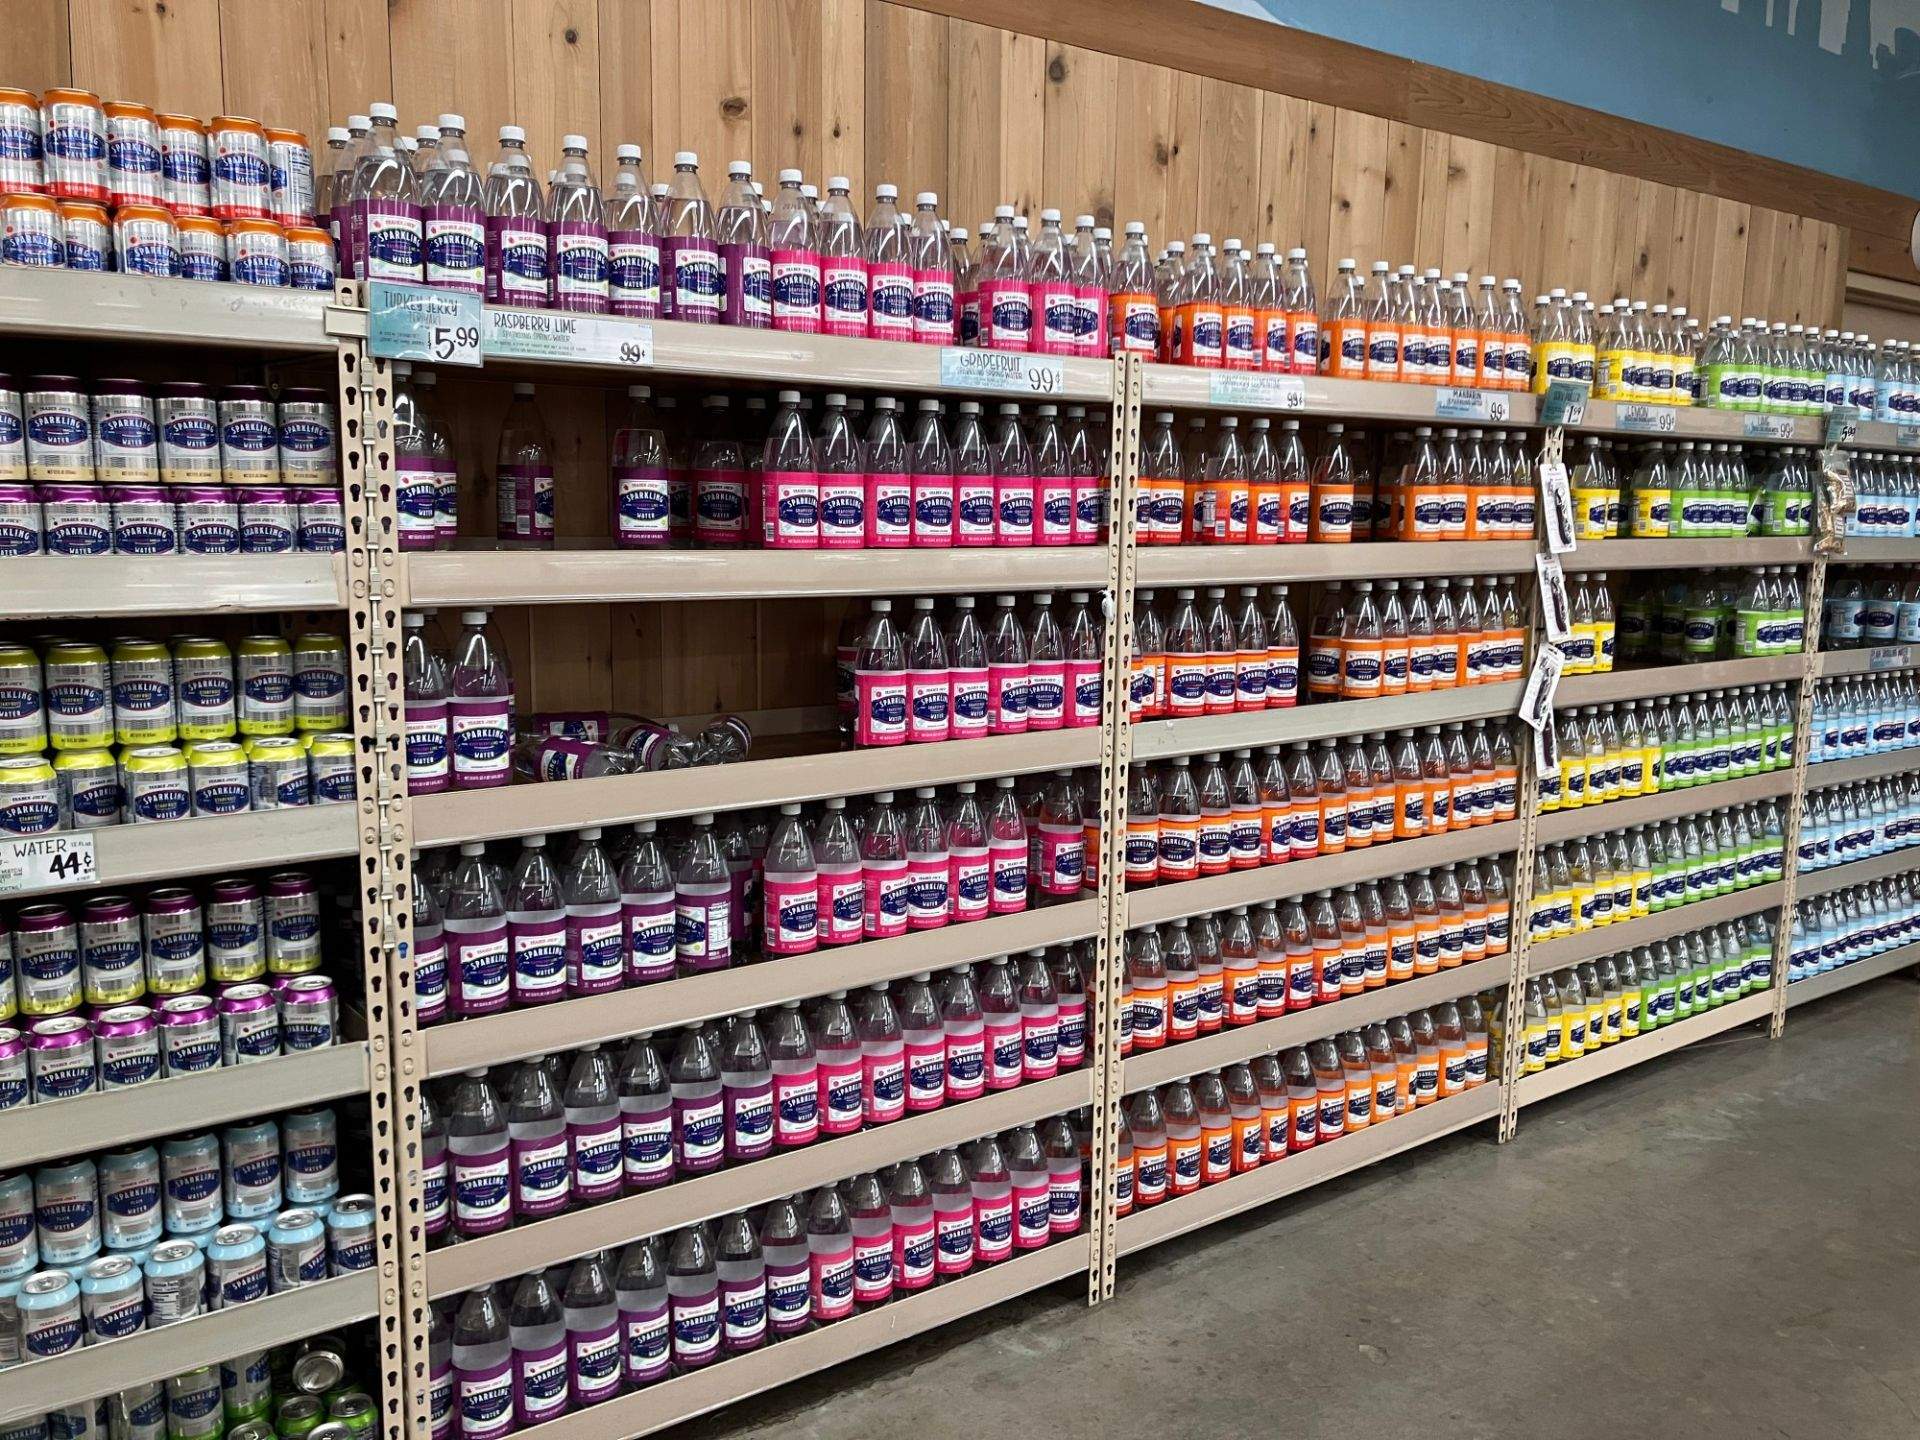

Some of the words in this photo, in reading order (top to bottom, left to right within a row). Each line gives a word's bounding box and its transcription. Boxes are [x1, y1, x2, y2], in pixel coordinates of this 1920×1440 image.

[379, 230, 420, 247] SPARKLING
[433, 234, 478, 250] SPARKLING
[392, 254, 412, 264] WATER
[565, 247, 606, 264] SPARKLING
[446, 259, 467, 268] WATER
[612, 257, 654, 274] SPARKLING
[524, 269, 542, 278] WATER
[579, 272, 598, 280] WATER
[624, 279, 643, 288] WATER
[781, 274, 817, 288] SPARKLING
[697, 284, 713, 294] WATER
[494, 313, 550, 332] RASPBERRY
[555, 320, 577, 334] LIME
[435, 326, 480, 360] 5.99
[960, 353, 1022, 372] GRAPEFRUIT
[35, 416, 80, 428] SPARKLING
[109, 419, 150, 431] SPARKLING
[173, 423, 214, 432] SPARKLING
[231, 424, 271, 434] SPARKLING
[285, 426, 323, 436] SPARKLING
[48, 436, 70, 444] WATER
[626, 489, 664, 502] SPARKLING
[828, 498, 861, 509] SPARKLING
[636, 512, 655, 520] WATER
[839, 517, 856, 525] WATER
[56, 527, 103, 538] SPARKLING
[122, 527, 166, 538] SPARKLING
[193, 527, 235, 538] SPARKLING
[244, 527, 282, 538] SPARKLING
[305, 526, 343, 537] SPARKLING
[254, 676, 291, 686] SPARKLING
[301, 672, 338, 681] SPARKLING
[119, 683, 161, 693] SPARKLING
[188, 680, 230, 690] SPARKLING
[1029, 683, 1060, 694] SPARKLING
[51, 688, 94, 698] SPARKLING
[462, 728, 504, 741] SPARKLING
[474, 751, 495, 759] WATER
[414, 756, 434, 765] WATER
[143, 792, 185, 802] SPARKLING
[203, 787, 243, 798] SPARKLING
[7, 804, 53, 817] SPARKLING
[156, 811, 176, 819] WATER
[13, 839, 67, 857] WATER
[914, 882, 945, 893] SPARKLING
[922, 899, 938, 907] WATER
[278, 916, 315, 926] SPARKLING
[158, 933, 199, 945] SPARKLING
[291, 932, 309, 940] WATER
[93, 941, 134, 954] SPARKLING
[524, 945, 563, 960] SPARKLING
[652, 946, 669, 954] WATER
[29, 952, 72, 964] SPARKLING
[171, 951, 191, 959] WATER
[106, 962, 126, 970] WATER
[470, 954, 507, 969] SPARKLING
[602, 957, 618, 966] WATER
[43, 971, 63, 979] WATER
[535, 968, 554, 976] WATER
[483, 976, 501, 985] WATER
[428, 983, 443, 994] WATER
[178, 1044, 217, 1058] SPARKLING
[259, 1047, 276, 1055] WATER
[111, 1055, 155, 1070] SPARKLING
[190, 1062, 210, 1070] WATER
[45, 1068, 88, 1082] SPARKLING
[125, 1074, 145, 1083] WATER
[58, 1087, 80, 1096] WATER
[798, 1113, 813, 1122] WATER
[754, 1125, 769, 1134] WATER
[631, 1133, 667, 1147] SPARKLING
[702, 1136, 718, 1146] WATER
[586, 1142, 620, 1158] SPARKLING
[641, 1153, 659, 1162] WATER
[529, 1157, 566, 1173] SPARKLING
[596, 1164, 614, 1173] WATER
[177, 1172, 216, 1186] SPARKLING
[254, 1177, 271, 1185] WATER
[464, 1176, 504, 1190] SPARKLING
[540, 1179, 559, 1189] WATER
[187, 1191, 207, 1200] WATER
[475, 1198, 496, 1207] WATER
[127, 1205, 147, 1214] WATER
[54, 1223, 75, 1231] WATER
[34, 1325, 76, 1340] SPARKLING
[117, 1325, 136, 1335] WATER
[693, 1334, 709, 1342] WATER
[649, 1347, 664, 1356] WATER
[597, 1367, 614, 1377] WATER
[544, 1386, 561, 1396] WATER
[469, 1387, 508, 1406] SPARKLING
[481, 1410, 500, 1419] WATER
